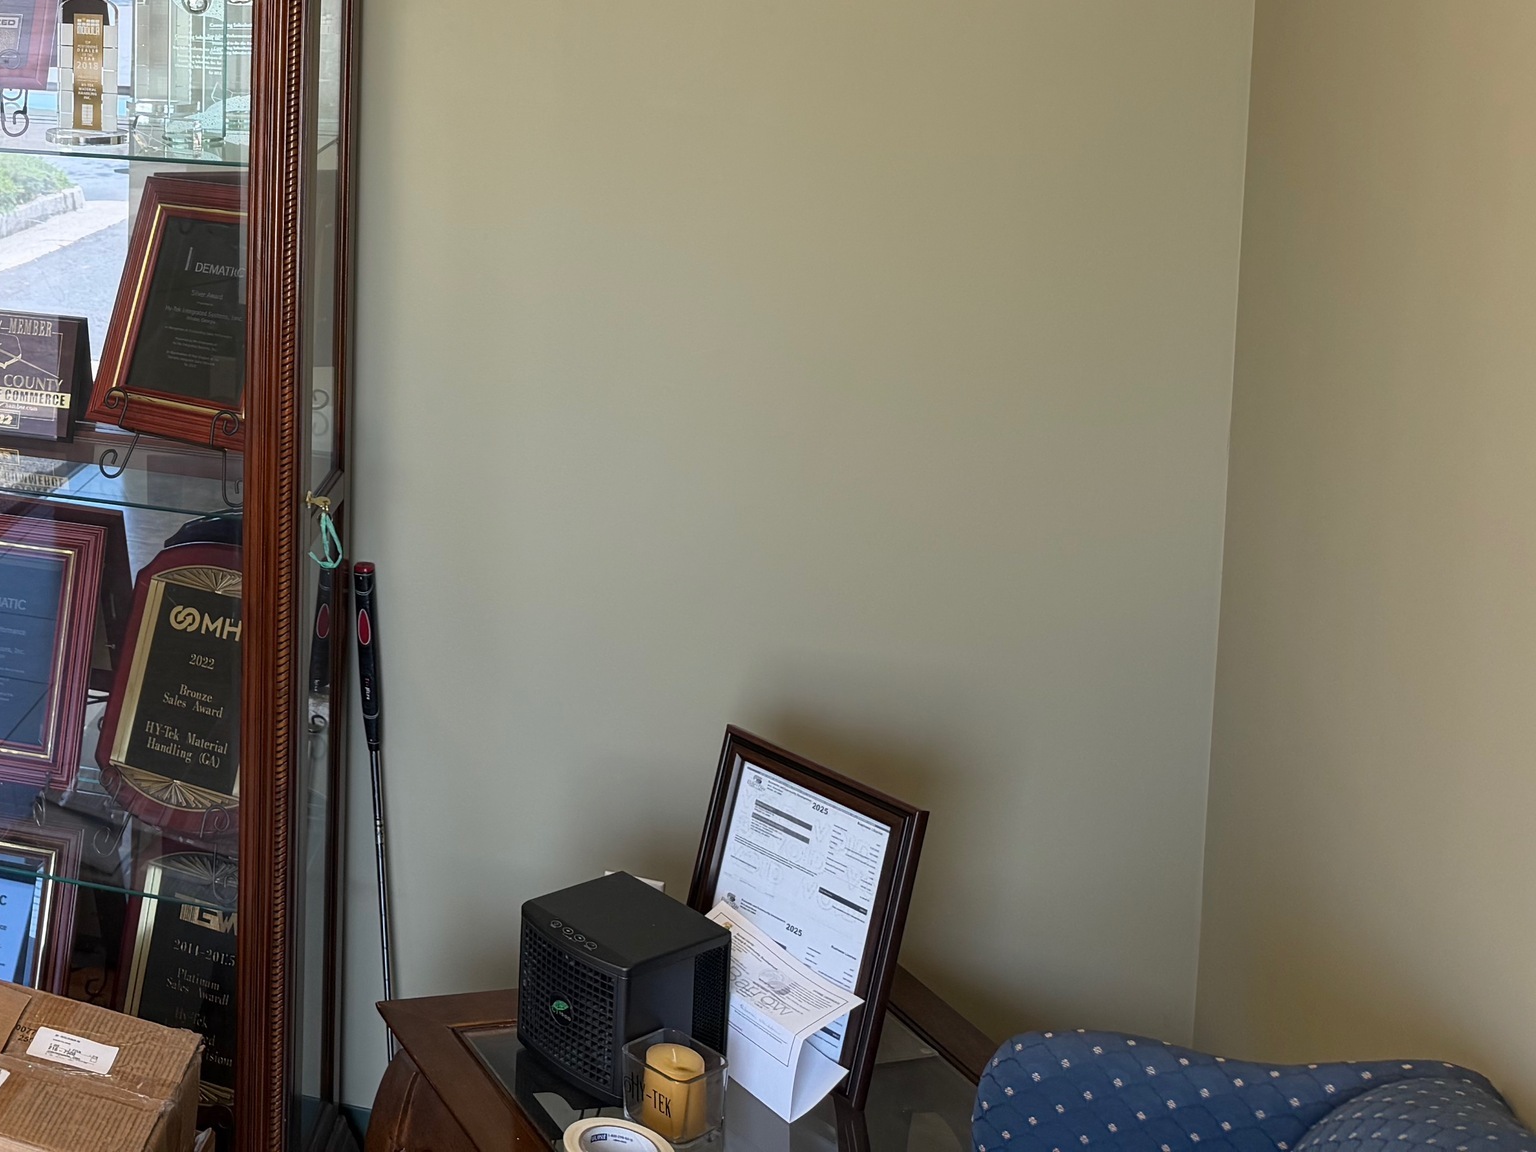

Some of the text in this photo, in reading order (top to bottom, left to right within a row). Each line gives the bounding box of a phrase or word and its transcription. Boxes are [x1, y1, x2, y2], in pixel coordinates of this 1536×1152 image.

[76, 62, 100, 71] 2018
[194, 262, 246, 278] DEMATIC
[8, 318, 53, 337] MEMBER
[4, 374, 64, 392] COUNTY
[4, 389, 66, 407] COMMERCE
[188, 653, 215, 670] 2022
[179, 683, 213, 703] Bronze
[163, 692, 224, 719] Sales Award
[145, 720, 228, 755] HY-Tek Material
[146, 736, 221, 769] Handling (GA)
[811, 802, 830, 816] 2025
[785, 922, 803, 937] 2025
[176, 967, 221, 992] Platinum
[165, 976, 230, 1006] Sales Award
[629, 1071, 672, 1119] HY-TEK
